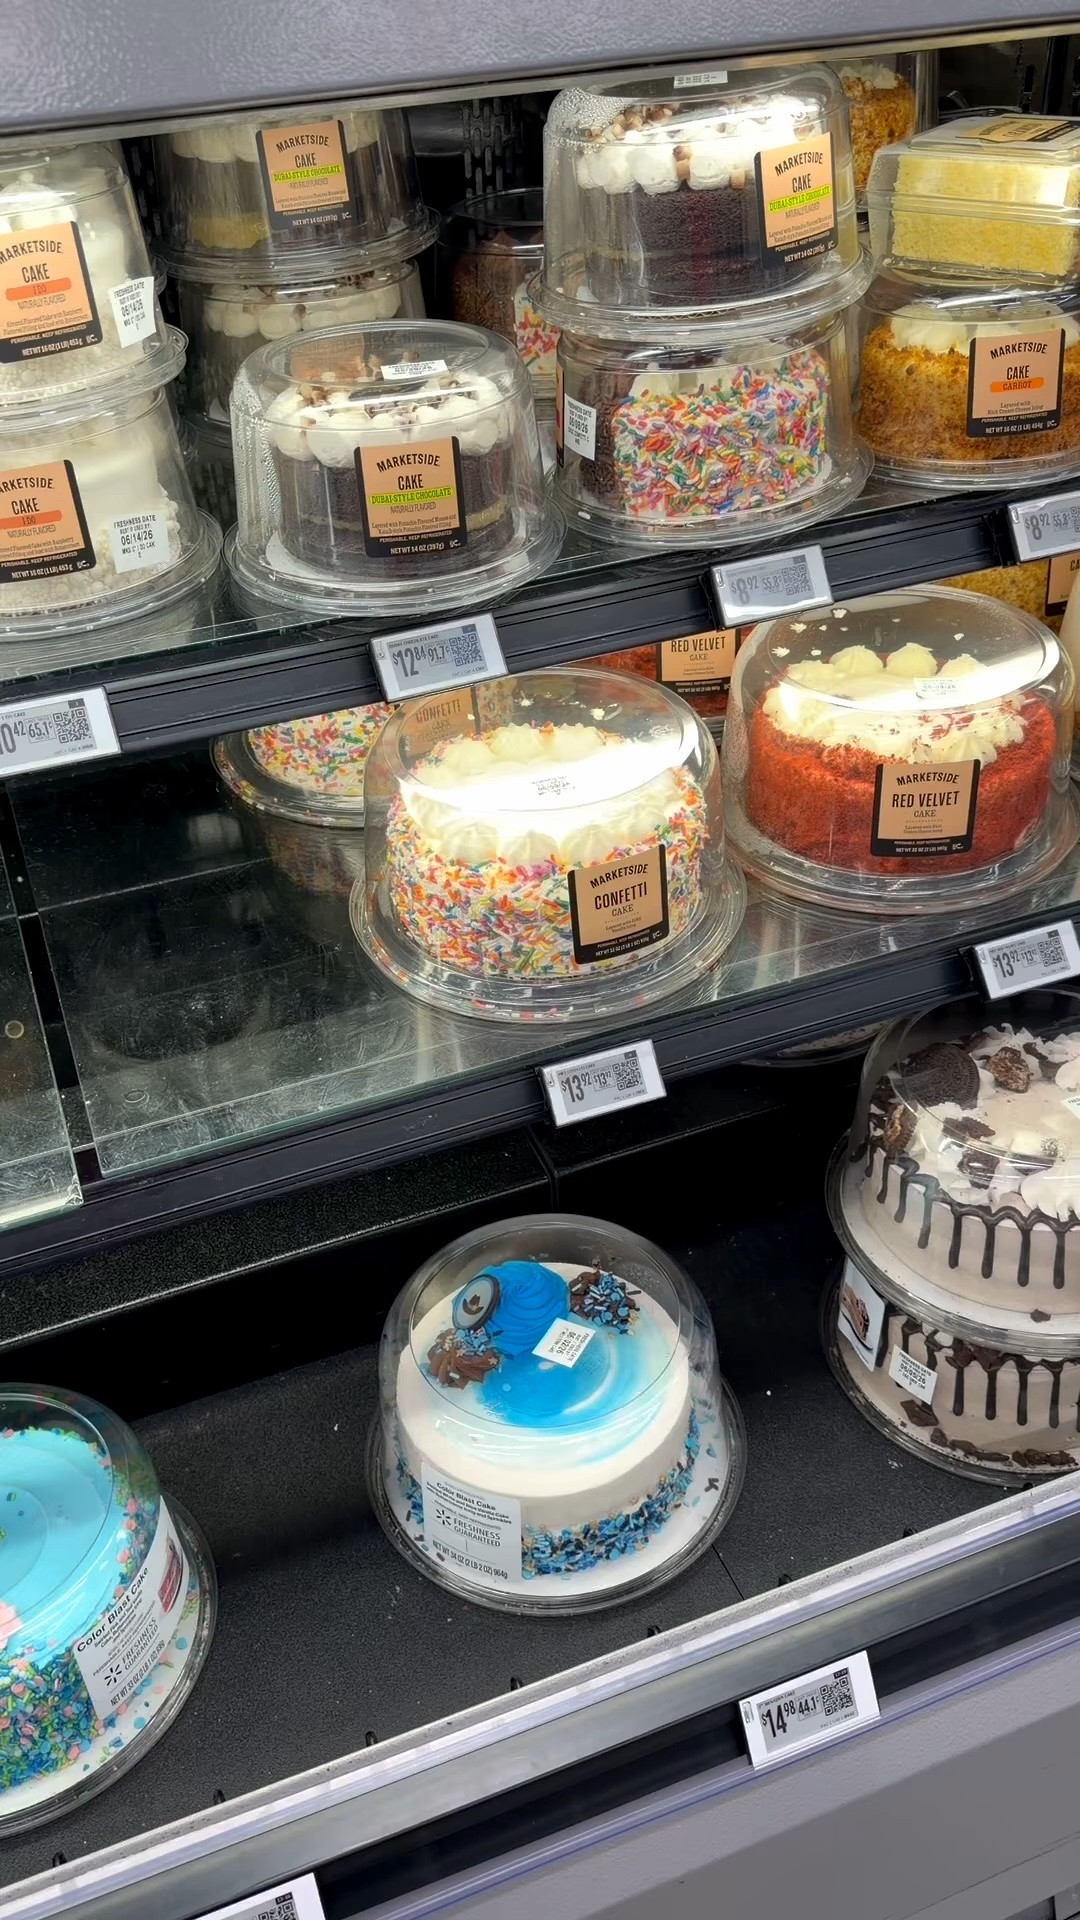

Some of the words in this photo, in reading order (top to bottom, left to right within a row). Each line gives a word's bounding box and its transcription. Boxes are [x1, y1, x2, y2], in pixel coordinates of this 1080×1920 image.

[276, 134, 329, 153] MARKETSIDE
[294, 153, 317, 169] CAKE
[774, 152, 823, 177] MARKETSIDE
[311, 165, 341, 177] CHOCOLATE
[791, 173, 812, 193] CAKE
[21, 263, 50, 284] CAKE
[37, 284, 47, 295] DO
[990, 342, 1048, 360] MARKETSIDE
[1006, 365, 1030, 381] CAKE
[1002, 380, 1033, 391] CARROT
[376, 453, 440, 473] MARKETSIDE
[0, 477, 54, 494] ARKETSIDE
[397, 473, 424, 491] CAKE
[371, 492, 415, 504] DUBAI-STYLE
[415, 487, 452, 500] CHOCOLATE
[11, 497, 40, 515] CAKE
[26, 516, 36, 525] DO
[114, 516, 141, 529] FRESHNESS
[141, 514, 156, 523] DATE
[33, 524, 57, 535] FLAVORED
[120, 529, 154, 546] 06/14/26
[401, 546, 411, 554] WT
[20, 570, 29, 578] WT
[58, 563, 69, 571] 453
[671, 639, 690, 653] RED
[692, 636, 726, 652] VELVET
[689, 653, 708, 662] CAKE
[896, 771, 960, 787] MARKETSIDE
[892, 793, 915, 808] RED
[918, 790, 960, 808] VELVET
[913, 809, 937, 818] CAKE
[589, 863, 649, 889] MARKETSIDE
[594, 882, 648, 910] CONFETTI
[612, 903, 634, 917] CAKE
[436, 1482, 455, 1496] Color
[456, 1490, 475, 1505] Blast
[476, 1500, 496, 1511] Cake
[487, 1514, 512, 1525] Sprinkles
[453, 1518, 501, 1540] FRESHNESS
[453, 1525, 501, 1547] GUARANTEED
[432, 1539, 442, 1550] NET
[442, 1545, 450, 1556] WT
[450, 1550, 458, 1560] 34
[457, 1554, 465, 1565] OZ
[465, 1558, 470, 1568] (2
[470, 1560, 478, 1571] LB
[483, 1565, 493, 1576] OZ)
[493, 1568, 508, 1580] 964g
[77, 1624, 106, 1653] Color
[107, 1595, 131, 1625] Blast
[130, 1567, 148, 1596] Cake
[122, 1618, 156, 1664] FRESHNESS
[124, 1624, 159, 1671] GUARANTEED
[110, 1691, 121, 1707] NET
[119, 1684, 128, 1699] WT
[126, 1679, 135, 1692] 33
[132, 1671, 140, 1685] OZ
[138, 1666, 145, 1679] (2
[142, 1660, 150, 1674] LB
